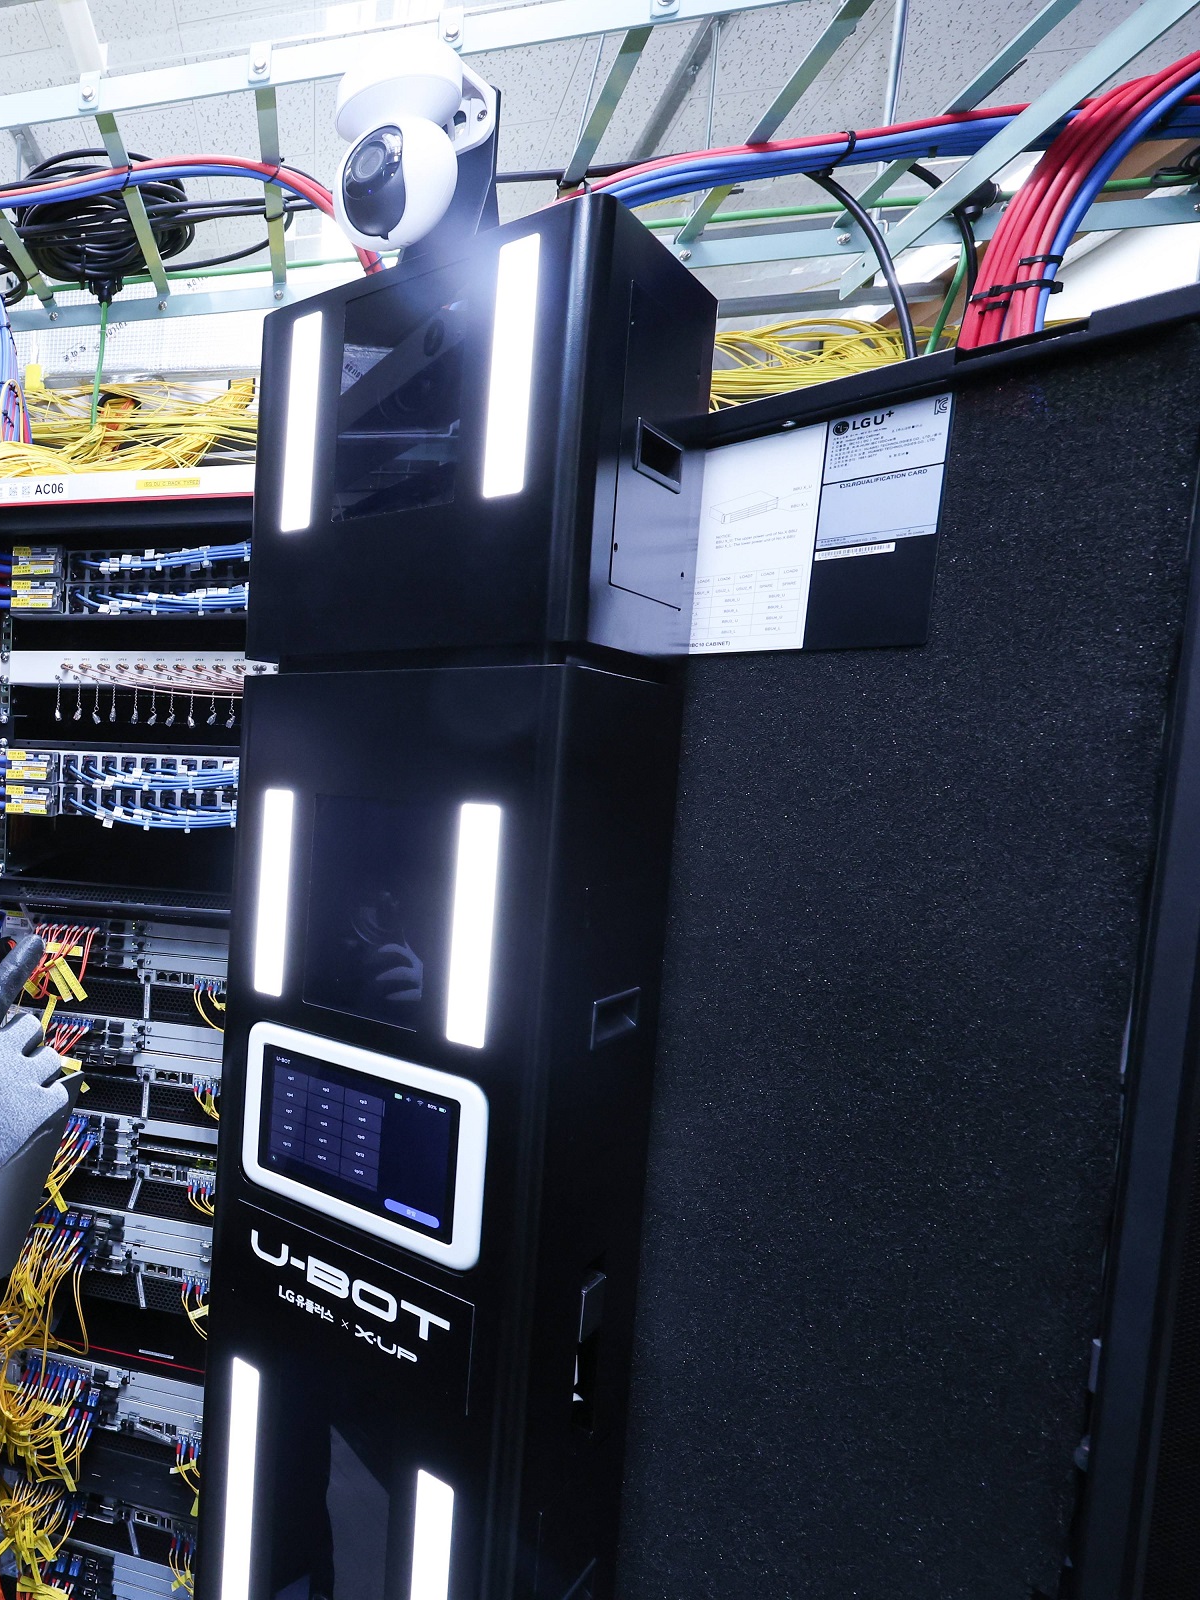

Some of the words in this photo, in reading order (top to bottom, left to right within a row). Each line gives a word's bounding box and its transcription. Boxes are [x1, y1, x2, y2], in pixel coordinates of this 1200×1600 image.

[852, 418, 871, 430] LG
[34, 483, 64, 495] AC06
[276, 1056, 291, 1064] U-BOT
[250, 1229, 450, 1341] U-BOT
